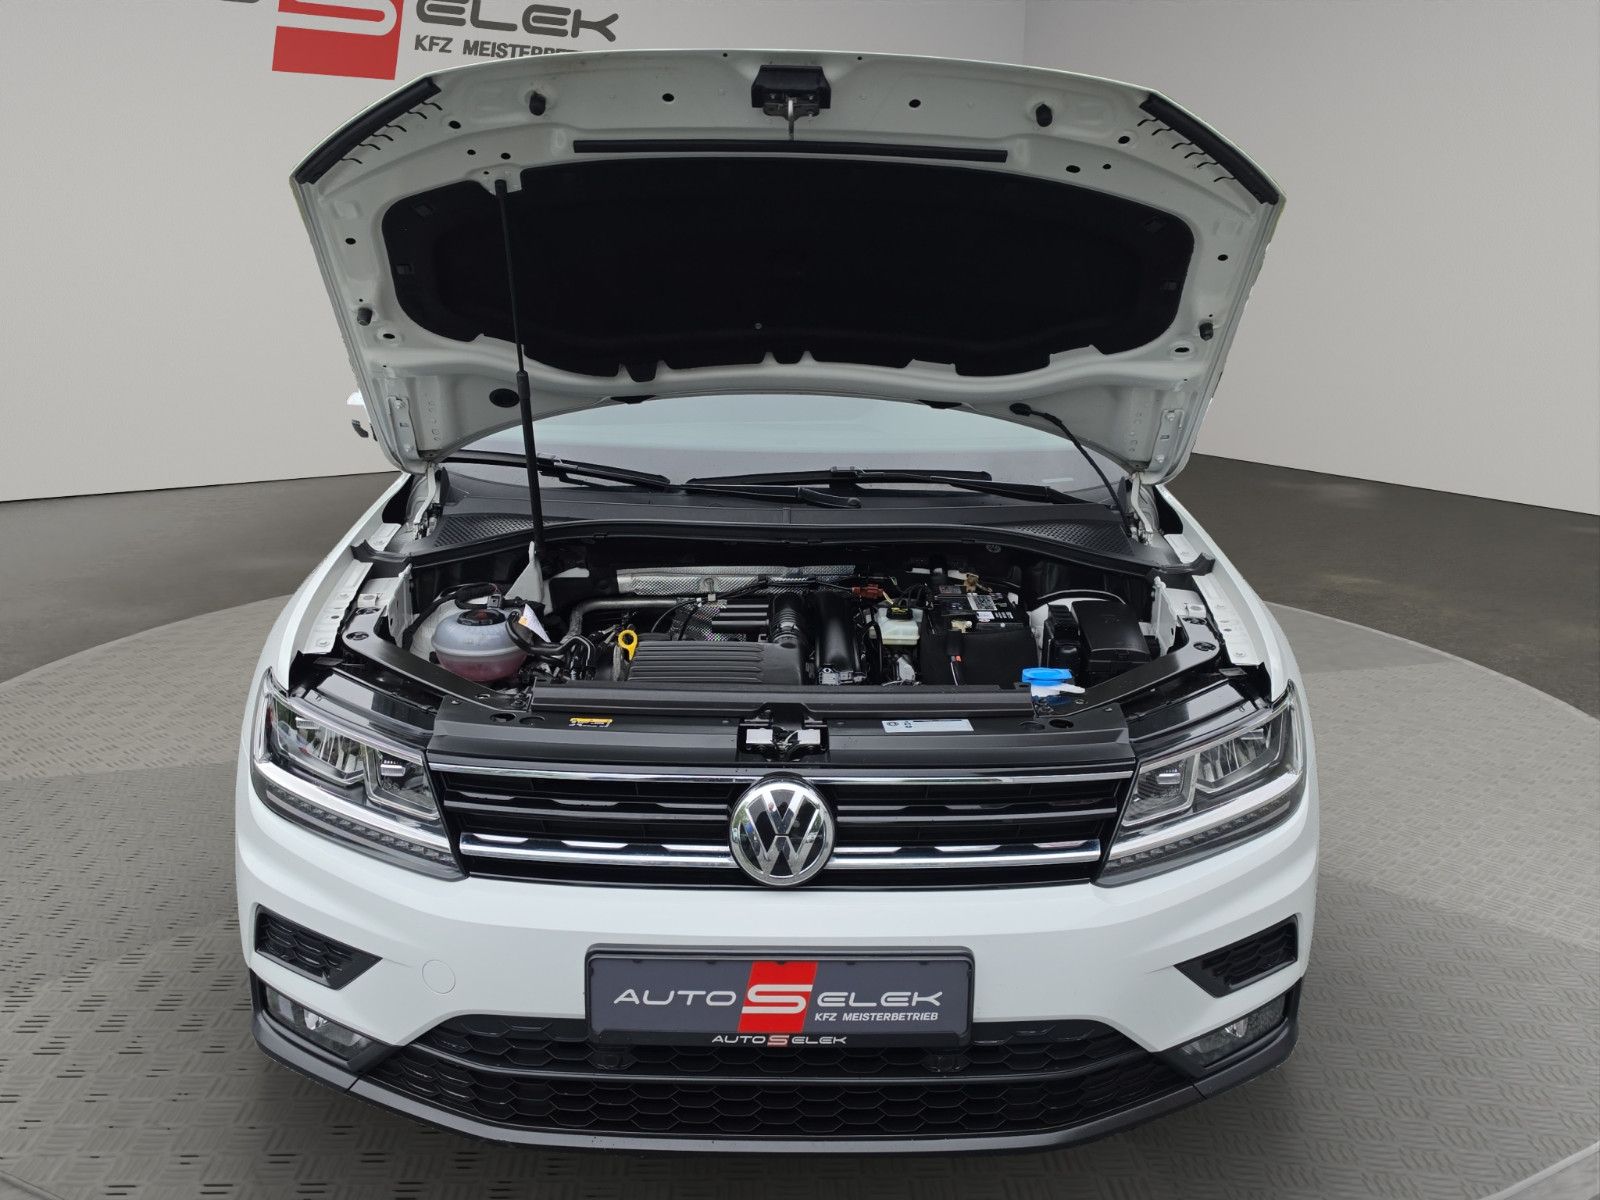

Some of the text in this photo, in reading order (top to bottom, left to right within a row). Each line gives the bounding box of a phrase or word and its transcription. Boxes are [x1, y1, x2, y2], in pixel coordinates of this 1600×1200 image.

[414, 34, 453, 54] KFZ
[613, 988, 737, 1007] AUTO
[814, 1012, 939, 1022] KFZ MEISTERBETRIEB
[711, 1035, 766, 1044] AUTO
